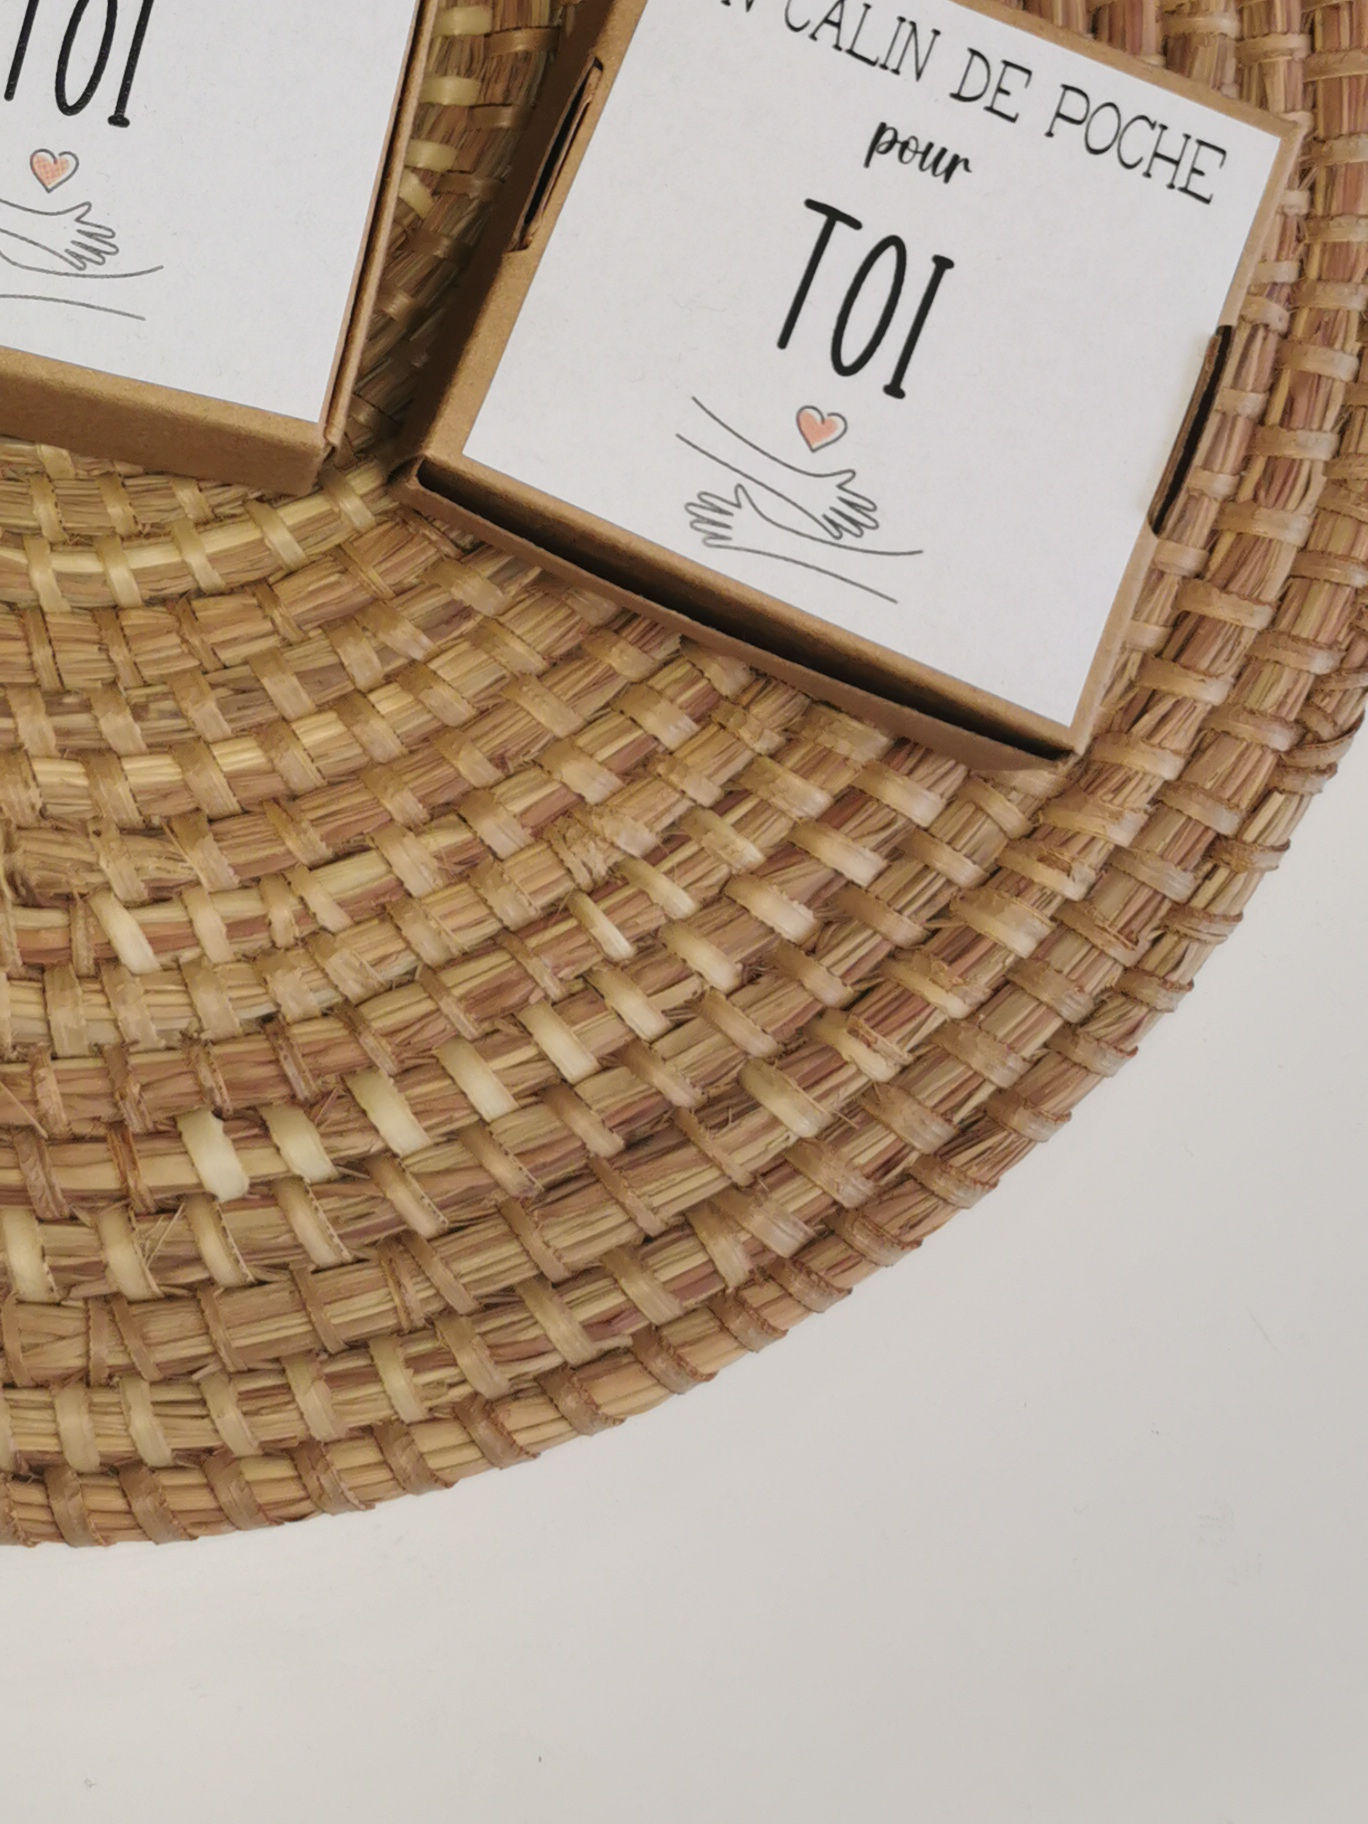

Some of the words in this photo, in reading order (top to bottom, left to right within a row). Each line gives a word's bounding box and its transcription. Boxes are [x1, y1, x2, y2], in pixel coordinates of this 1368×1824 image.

[863, 121, 972, 185] pour
[949, 47, 1033, 124] DE
[1044, 83, 1228, 205] POCHE
[776, 198, 956, 400] TOI
